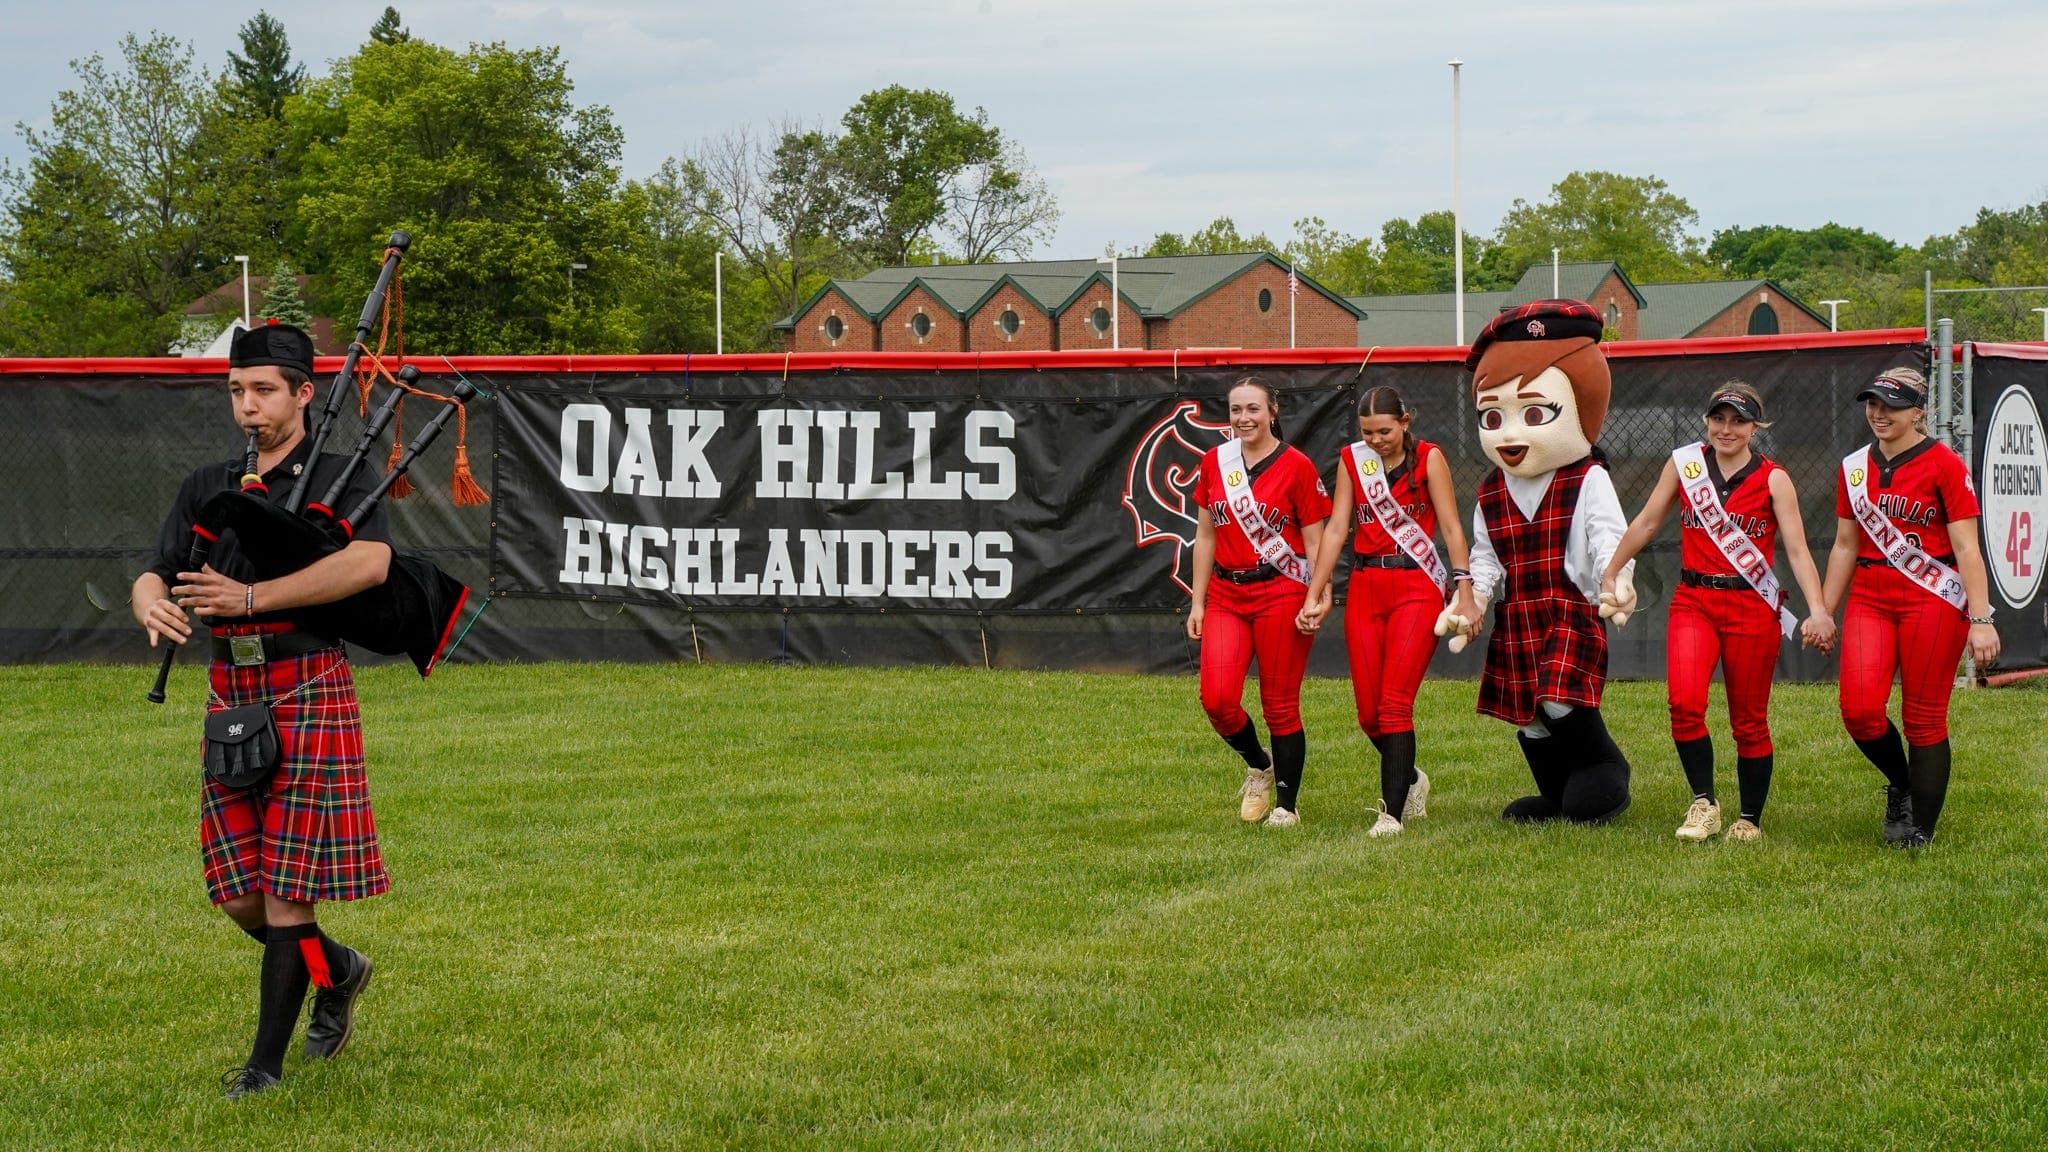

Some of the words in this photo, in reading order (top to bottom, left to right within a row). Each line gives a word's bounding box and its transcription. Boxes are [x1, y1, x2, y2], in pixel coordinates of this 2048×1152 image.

[559, 403, 725, 499] OAK
[755, 409, 1017, 501] HILLS
[2000, 423, 2034, 456] JACKIE
[1993, 463, 2042, 497] ROBINSON
[1878, 493, 1937, 527] HILLS
[1264, 540, 1284, 560] 2026
[1399, 526, 1418, 544] 2026
[1724, 536, 1745, 554] 2026
[2005, 511, 2032, 577] 42
[558, 516, 1015, 600] HIGHLANDERS
[1890, 543, 1908, 563] 2026
[1940, 578, 1962, 599] #3
